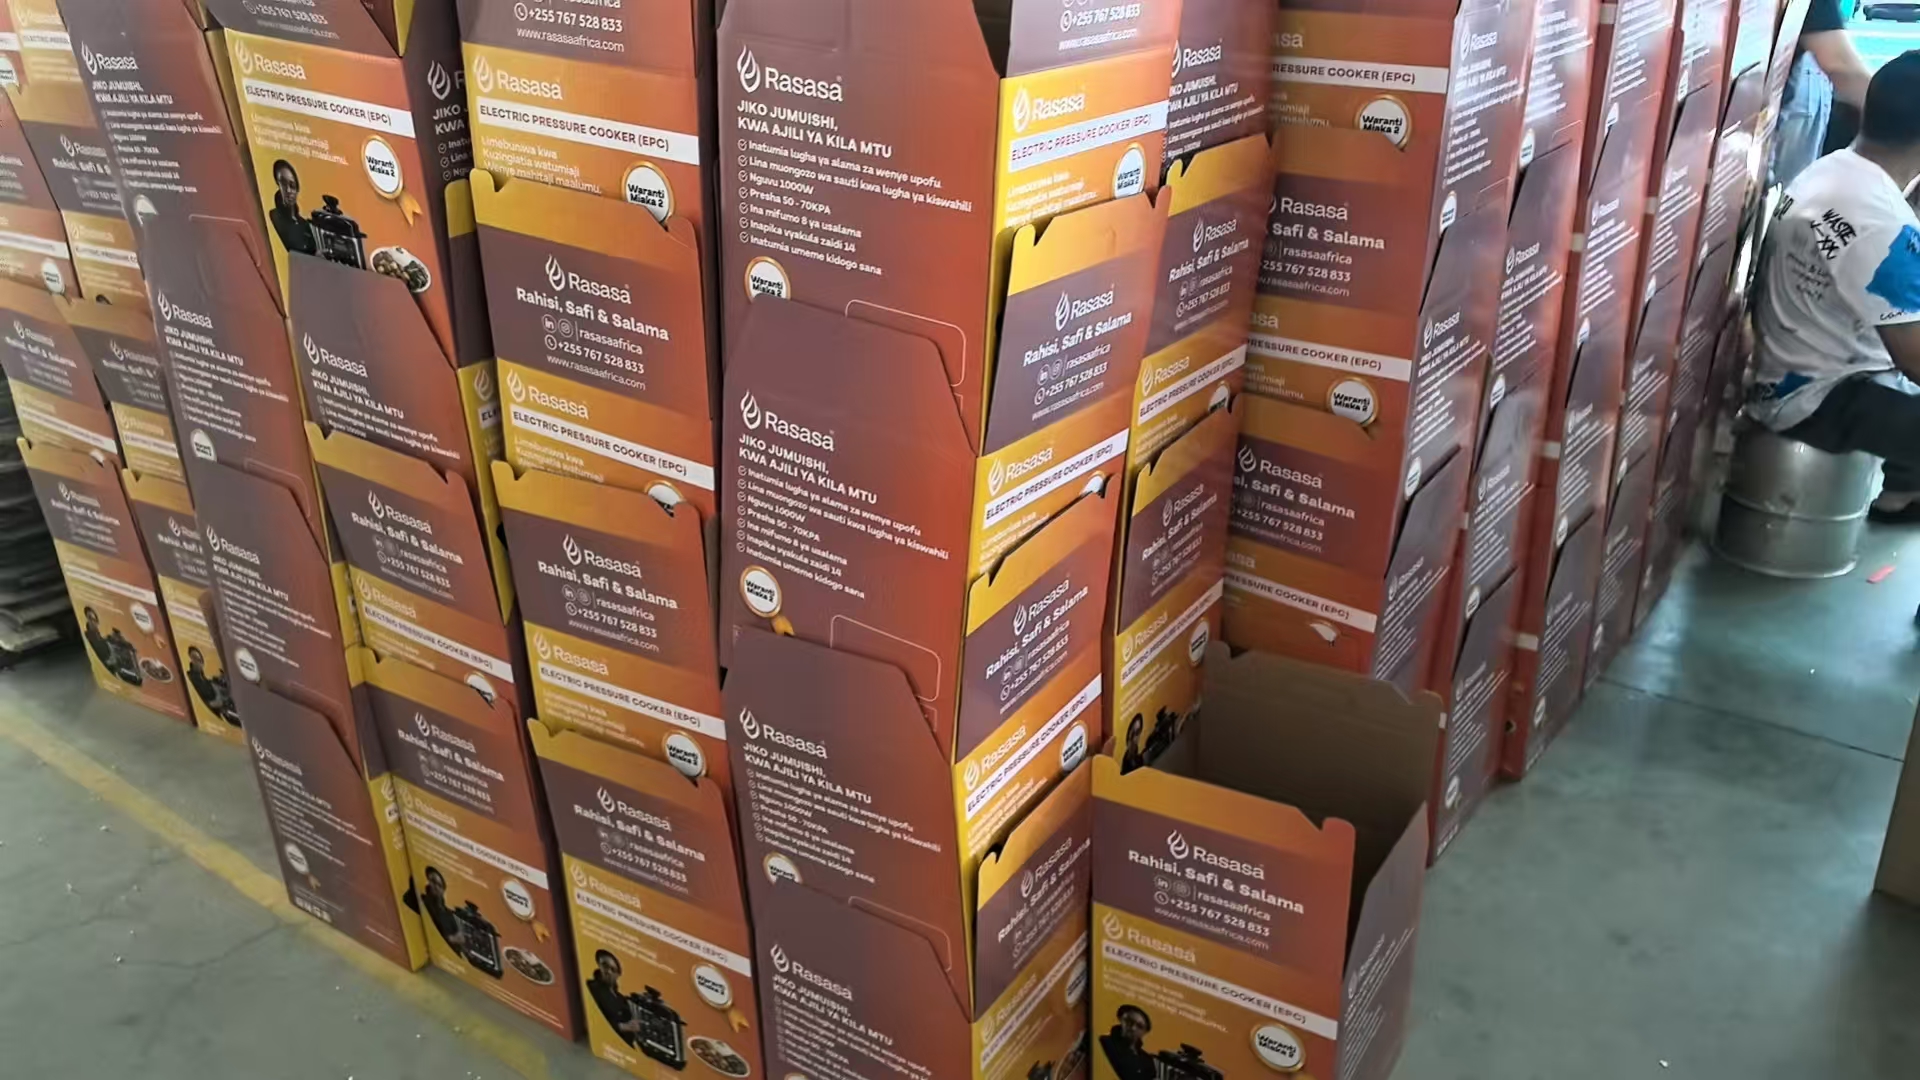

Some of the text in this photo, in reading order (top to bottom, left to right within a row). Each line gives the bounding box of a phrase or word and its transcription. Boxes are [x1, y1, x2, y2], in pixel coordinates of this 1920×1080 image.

[528, 7, 622, 32] +255 767 528 833
[95, 52, 138, 71] Rasasa
[253, 54, 306, 80] Rasasa
[1182, 45, 1221, 69] Rasasa
[496, 69, 563, 100] Rasasa
[765, 66, 843, 102] Rasasa
[1272, 61, 1415, 85] RESSURE COOKER (EPC)
[737, 99, 838, 131] JIKO JUMUISHI,
[1031, 93, 1085, 121] Rasasa
[1362, 114, 1403, 127] Waranti
[479, 104, 669, 152] ELECTRIC PRESSURE COOKER (EPC)
[737, 116, 892, 158] KWA AJILI YA KILA MTU
[1011, 113, 1151, 161] ELECTRIC PRESSURE COOKER (EPC)
[748, 140, 942, 188] Inatumia lugha ya alama za wenye upofu
[628, 184, 665, 198] Waranti
[749, 172, 814, 194] Nguvu 1000W
[749, 156, 972, 212] Lina muongozo wa sauti kwa lugha ya kiswahili
[749, 187, 781, 203] Presha
[782, 195, 794, 206] 50
[800, 199, 831, 215] 70KPA
[1280, 197, 1347, 221] Rasasa
[749, 203, 862, 238] Ina mifumo 8 ya usalama
[750, 219, 856, 253] Inapika vyakula zaidi 14
[1272, 222, 1385, 249] Safi & Salama
[750, 234, 882, 275] Inatumia umeme kidogo sana
[1283, 247, 1352, 265] rasasaafrica
[568, 271, 631, 304] Rasasa
[751, 275, 783, 289] Waranti
[1285, 263, 1305, 274] 767
[1307, 266, 1328, 279] 528
[1329, 269, 1351, 282] 833
[516, 287, 669, 341] Rahisi, Safi & Salama
[1068, 290, 1113, 320] Rasasa
[579, 329, 643, 355] rasasaafrica
[1023, 311, 1132, 367] Rahisi, Safi & Salama
[320, 347, 368, 378] Rasasa
[558, 341, 644, 374] +255 767 528 833
[1065, 343, 1111, 370] rasasaafrica
[527, 385, 589, 420] Rasasa
[512, 411, 687, 476] ELECTRIC PRESSURE COOKER (EPC)
[765, 411, 834, 451] Rasasa
[1002, 447, 1053, 483] Rasasa
[1259, 459, 1322, 489] Rasasa
[583, 549, 642, 578] Rasasa
[537, 560, 678, 609] Rahisi, Safi & Salama
[575, 608, 657, 638] +255 767 528 833
[596, 598, 654, 621] rasasaafrica
[762, 723, 828, 759] Rasasa
[1193, 845, 1264, 880] Rasasa
